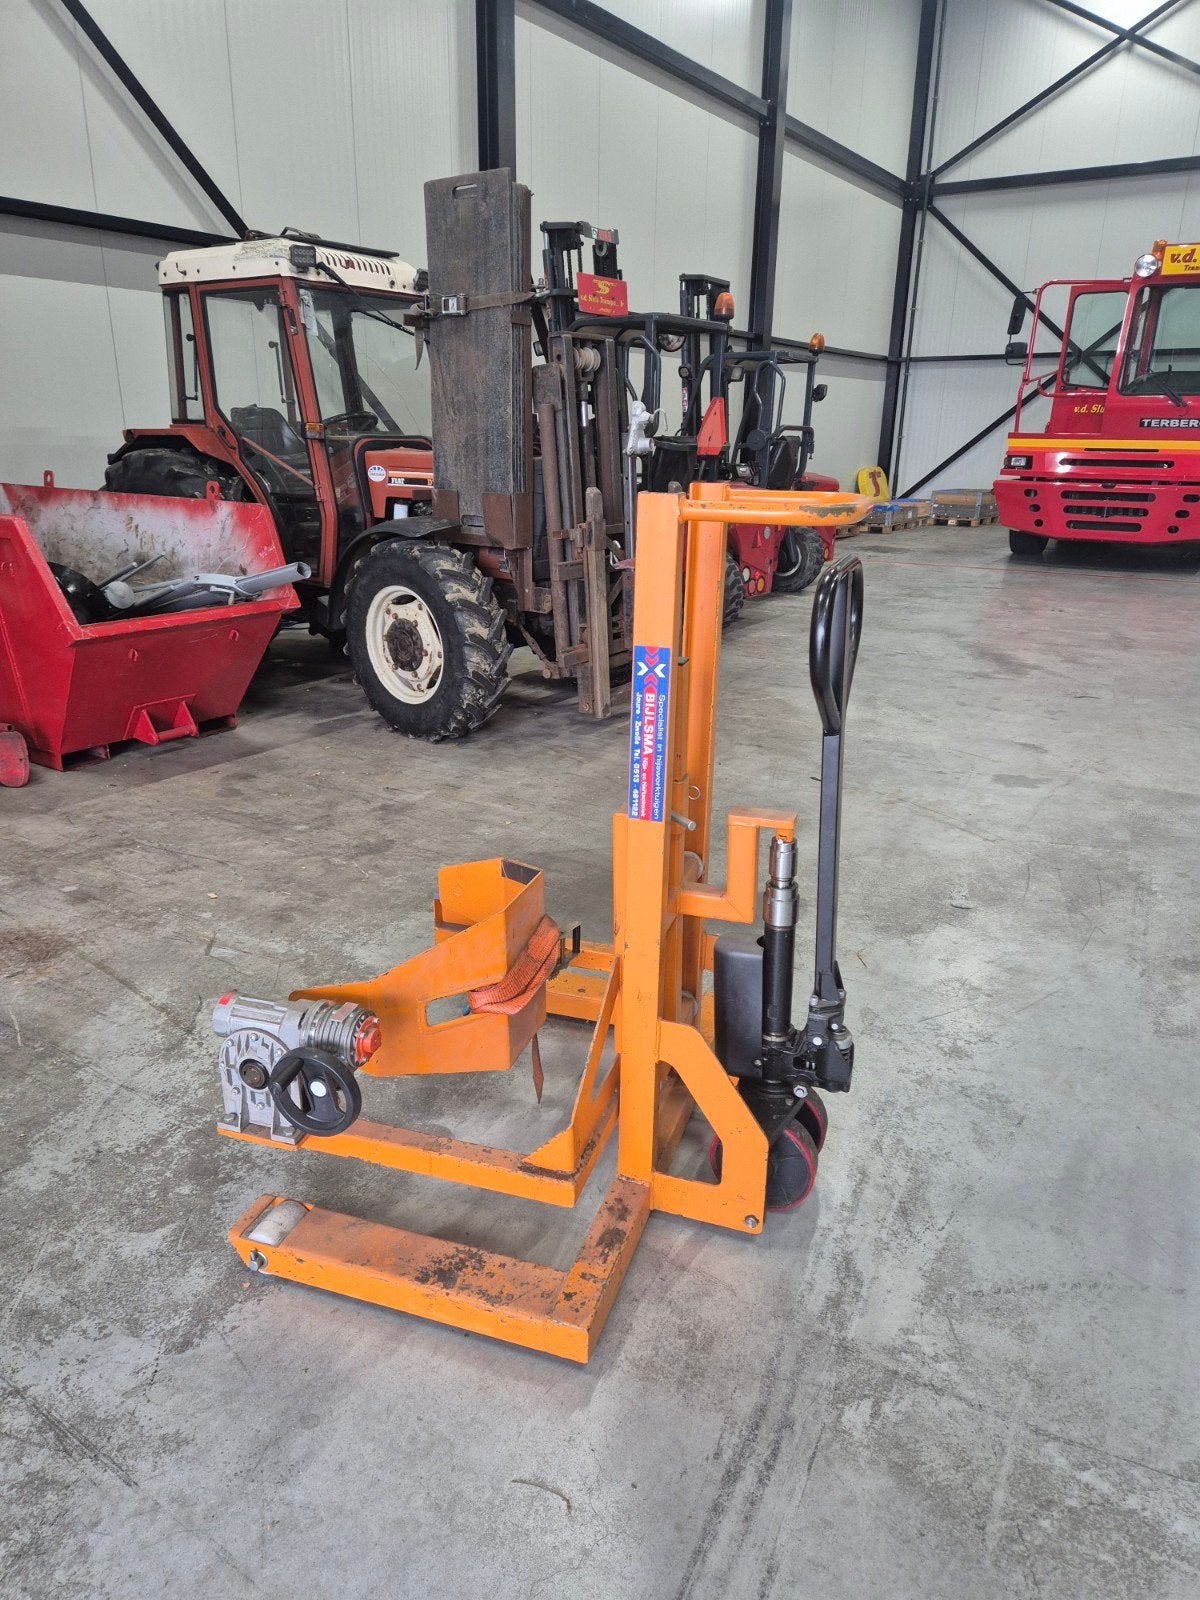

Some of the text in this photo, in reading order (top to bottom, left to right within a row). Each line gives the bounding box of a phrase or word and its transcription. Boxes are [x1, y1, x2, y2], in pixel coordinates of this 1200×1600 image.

[1170, 248, 1197, 263] v.d.
[1142, 419, 1200, 428] TERBER
[391, 477, 405, 485] FIAT
[643, 693, 655, 755] BIJLSMA
[653, 694, 665, 820] Specialist in hijswerktuigen
